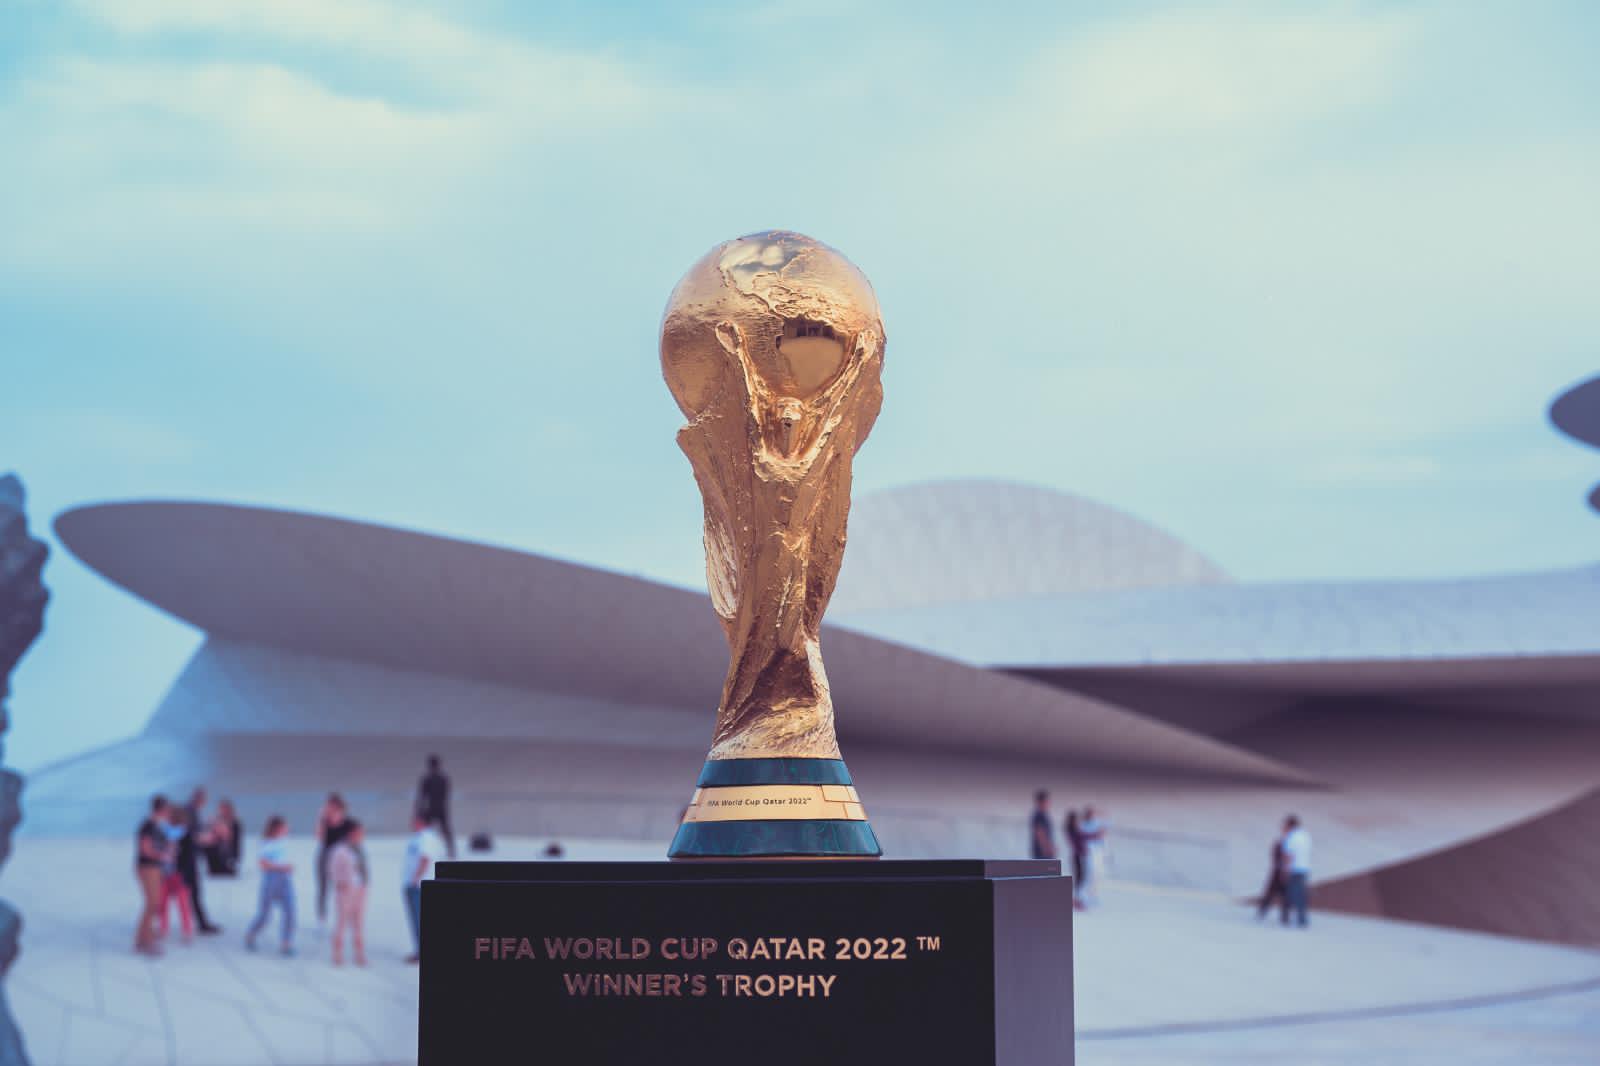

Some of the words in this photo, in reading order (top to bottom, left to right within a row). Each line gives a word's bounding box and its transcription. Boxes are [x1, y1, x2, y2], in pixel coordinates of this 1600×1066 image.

[744, 798, 760, 807] Cup
[788, 797, 812, 805] 2022
[474, 937, 536, 960] FIFA
[544, 937, 651, 960] WORLD
[660, 937, 718, 960] CUP
[727, 937, 826, 961] QATAR
[835, 937, 907, 961] 2022
[563, 973, 707, 997] WINNER'S
[715, 974, 837, 998] TROPHY
